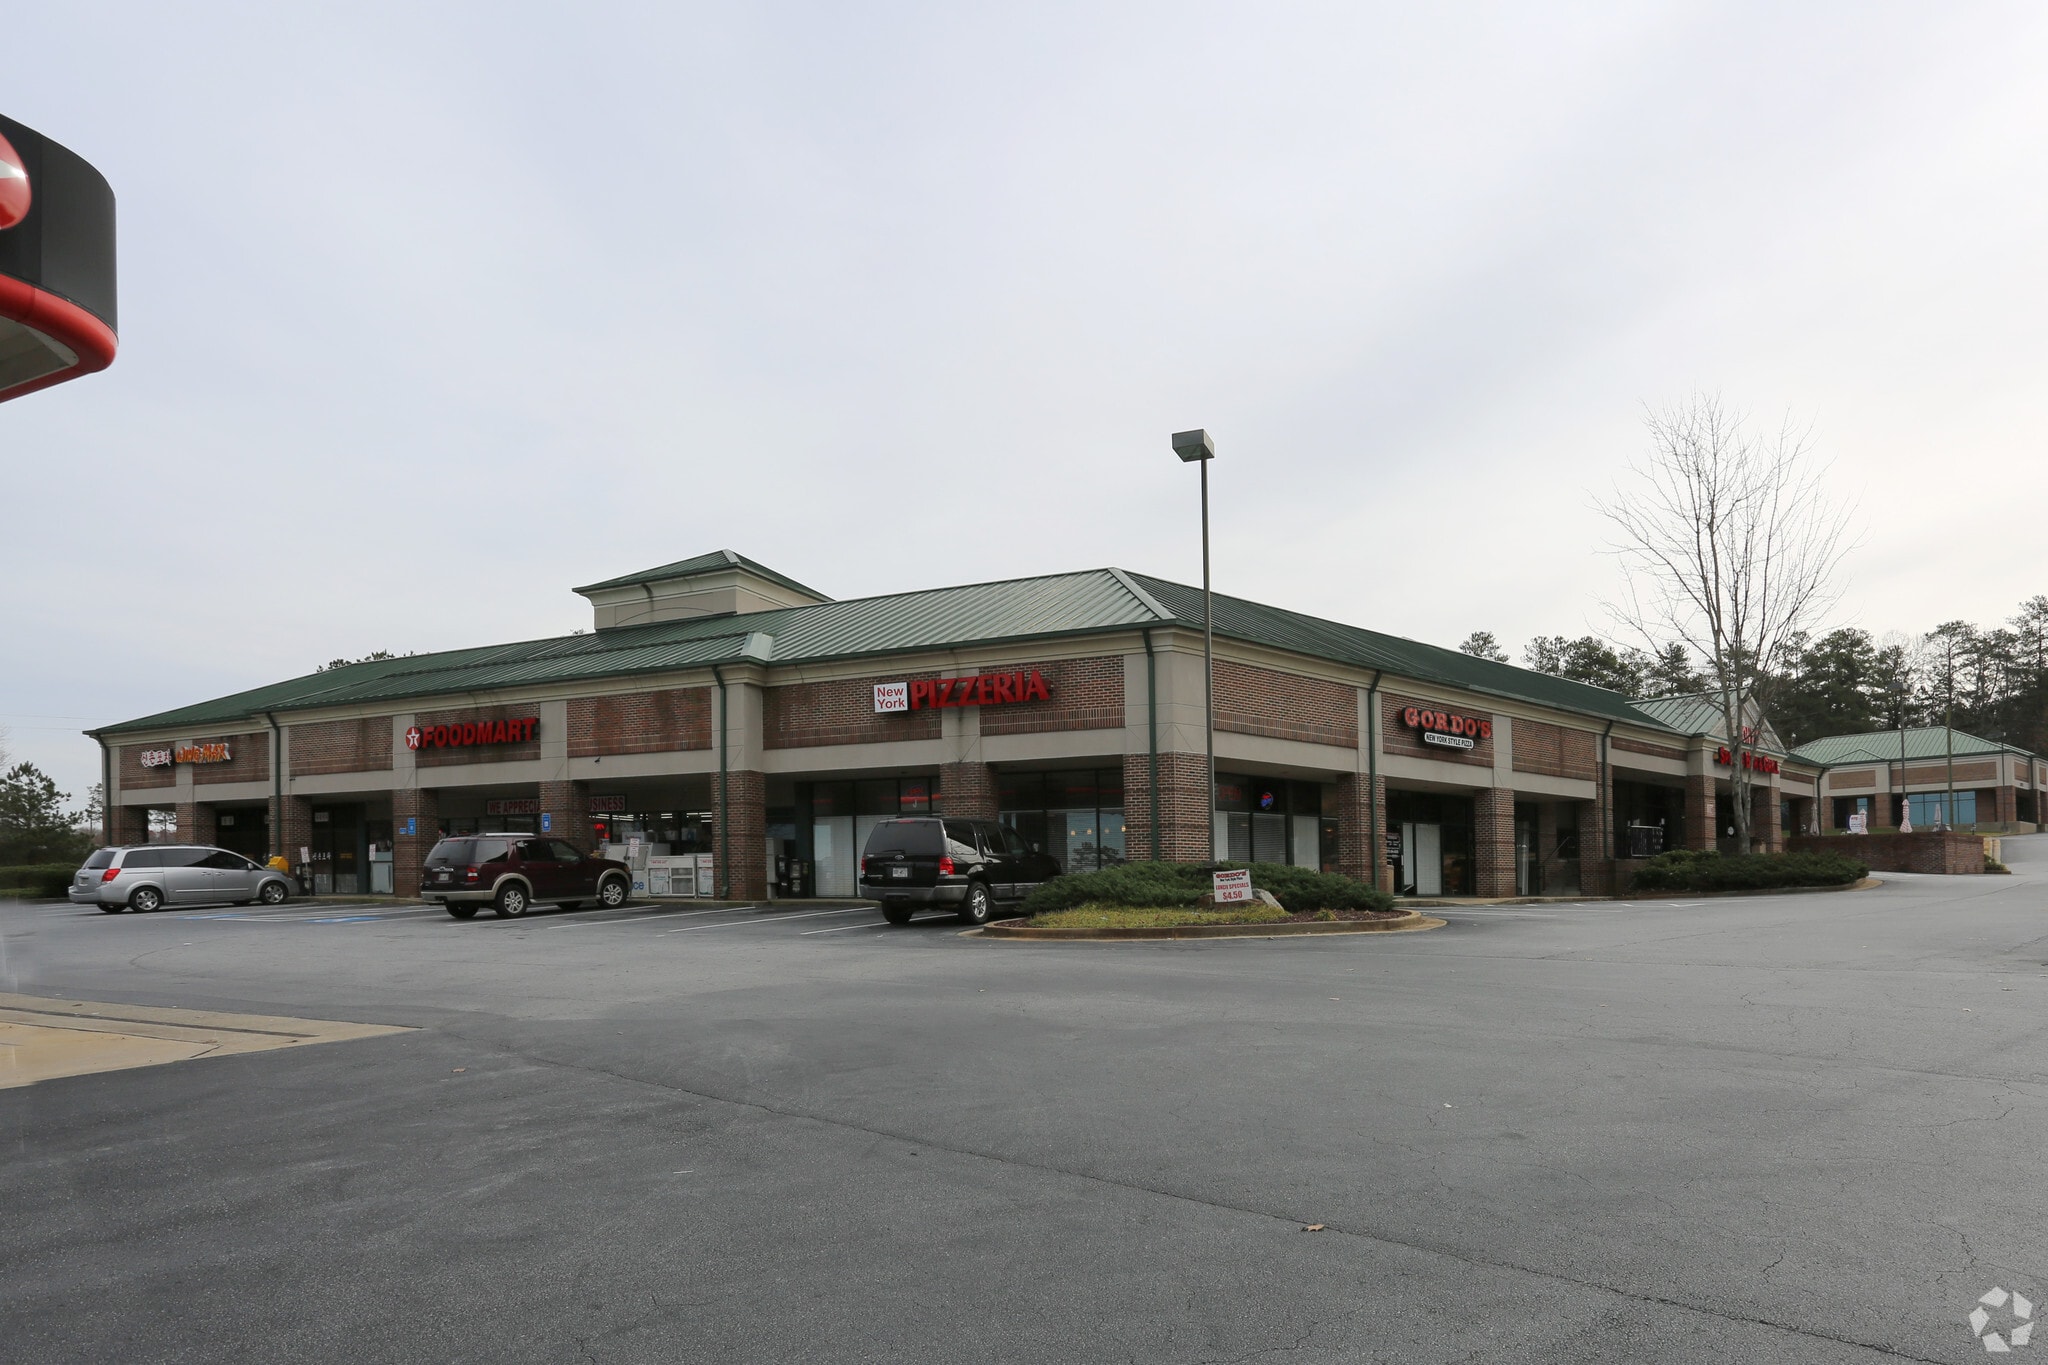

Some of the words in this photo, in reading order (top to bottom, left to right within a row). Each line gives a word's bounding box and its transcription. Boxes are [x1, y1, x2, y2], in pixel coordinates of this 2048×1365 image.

[876, 686, 904, 698] New
[910, 669, 1050, 711] PIZZERIA
[876, 698, 906, 709] York
[1404, 706, 1492, 739] GORDO'S
[422, 717, 538, 749] FOODMART
[1426, 733, 1436, 742] NEW
[1436, 735, 1447, 744] YORK
[1447, 738, 1461, 746] STYLE
[1461, 739, 1473, 748] PIZZA
[489, 800, 501, 814] WE
[503, 799, 540, 814] APPRECIA
[588, 796, 624, 811] USINESS
[632, 881, 645, 890] ce
[1222, 890, 1243, 900] $4.50
